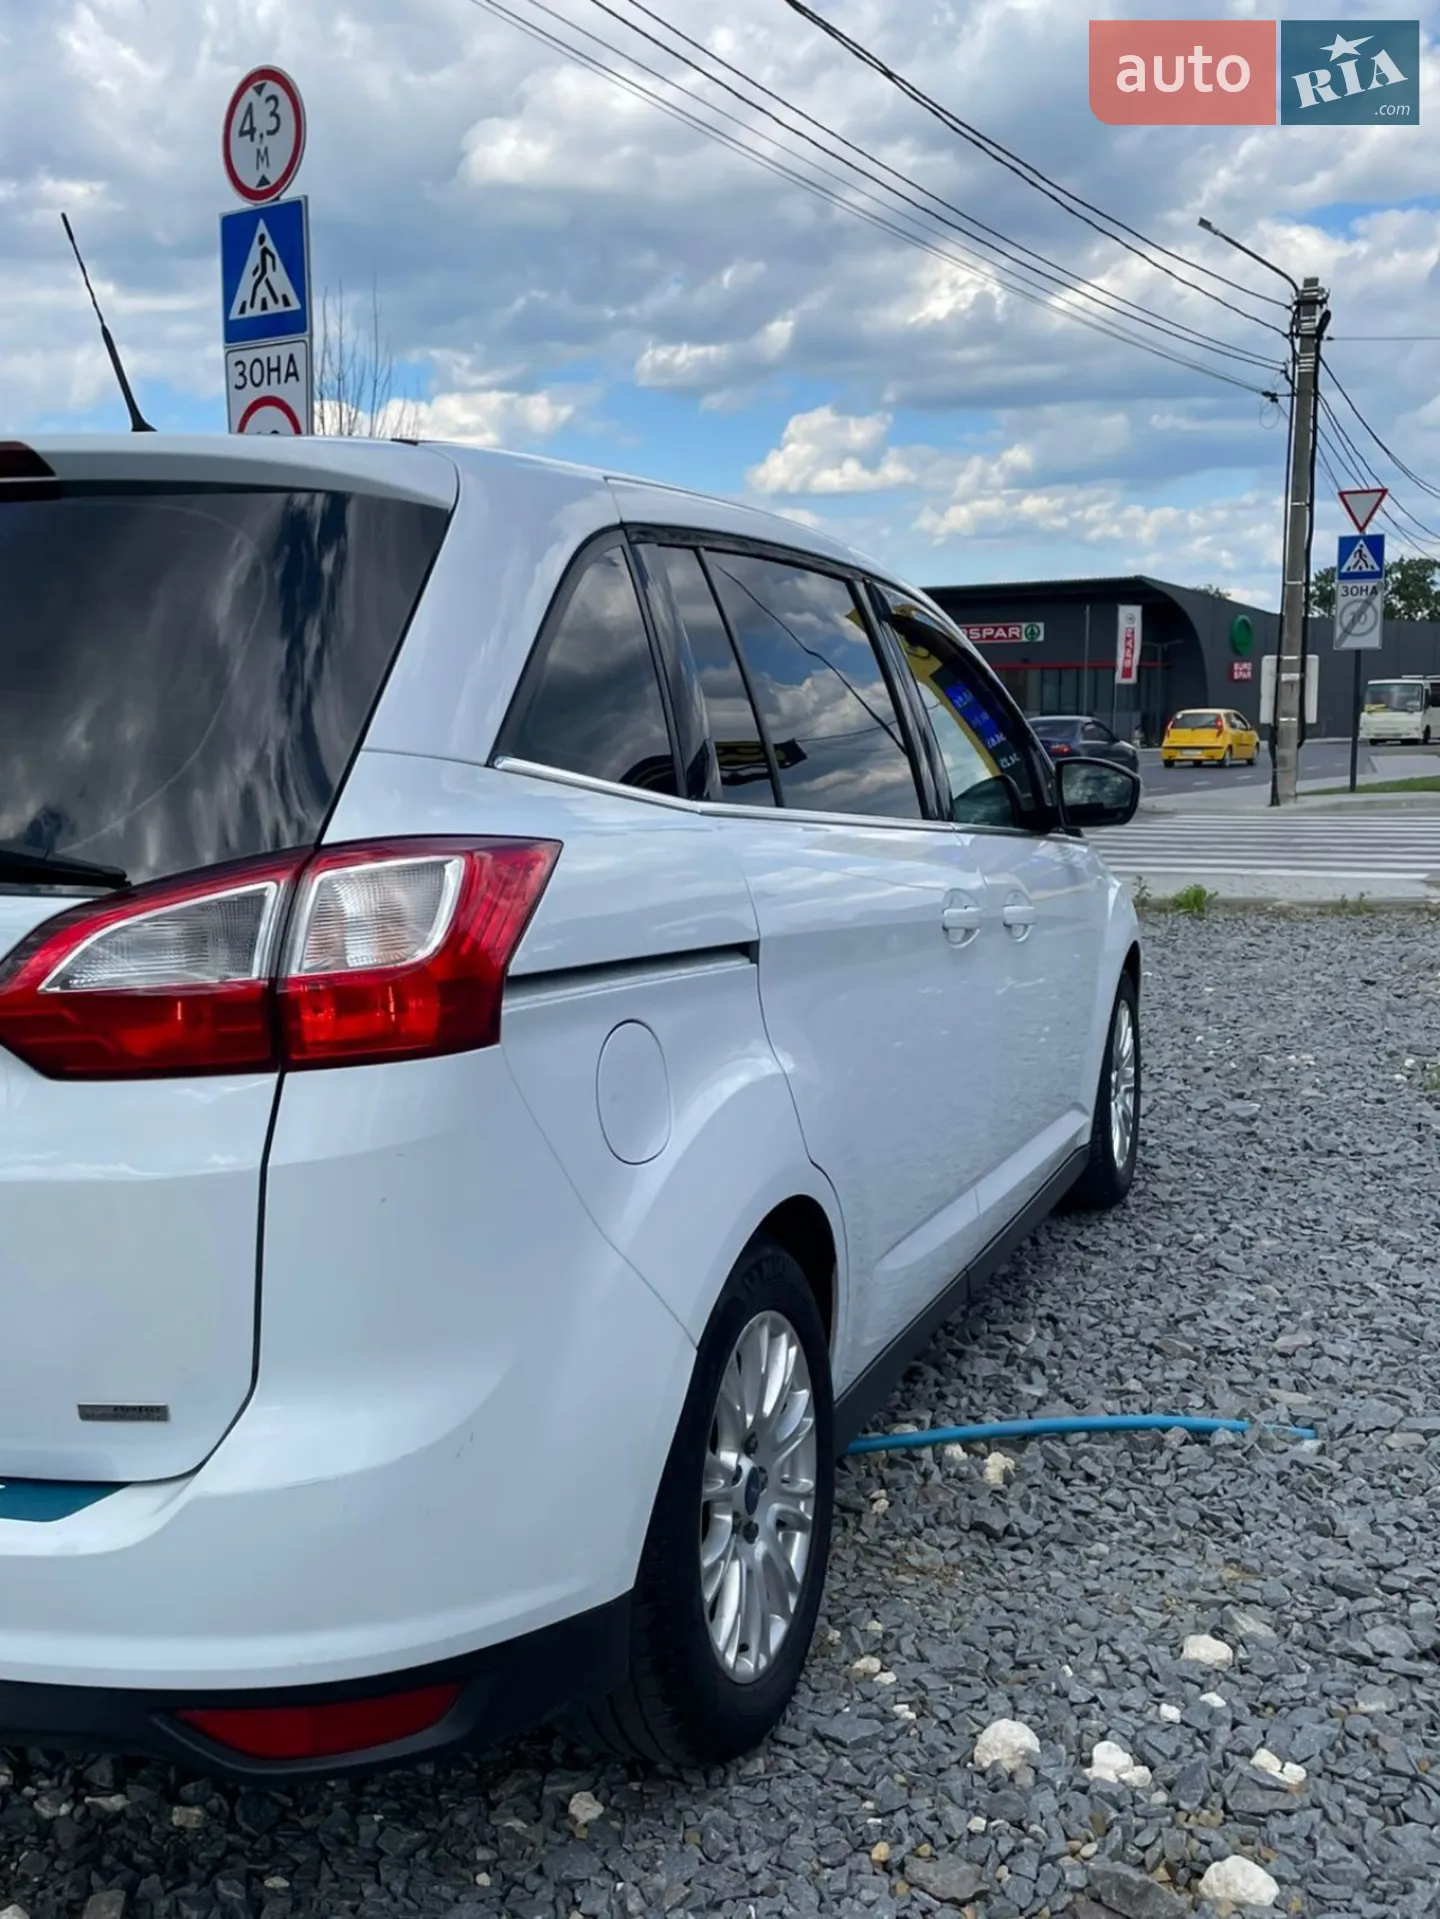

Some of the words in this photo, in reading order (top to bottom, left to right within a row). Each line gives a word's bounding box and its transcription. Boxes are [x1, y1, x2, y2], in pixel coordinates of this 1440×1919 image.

[238, 93, 281, 144] 4,3
[233, 353, 300, 391] ЗОНА
[1340, 584, 1379, 597] ЗОНА
